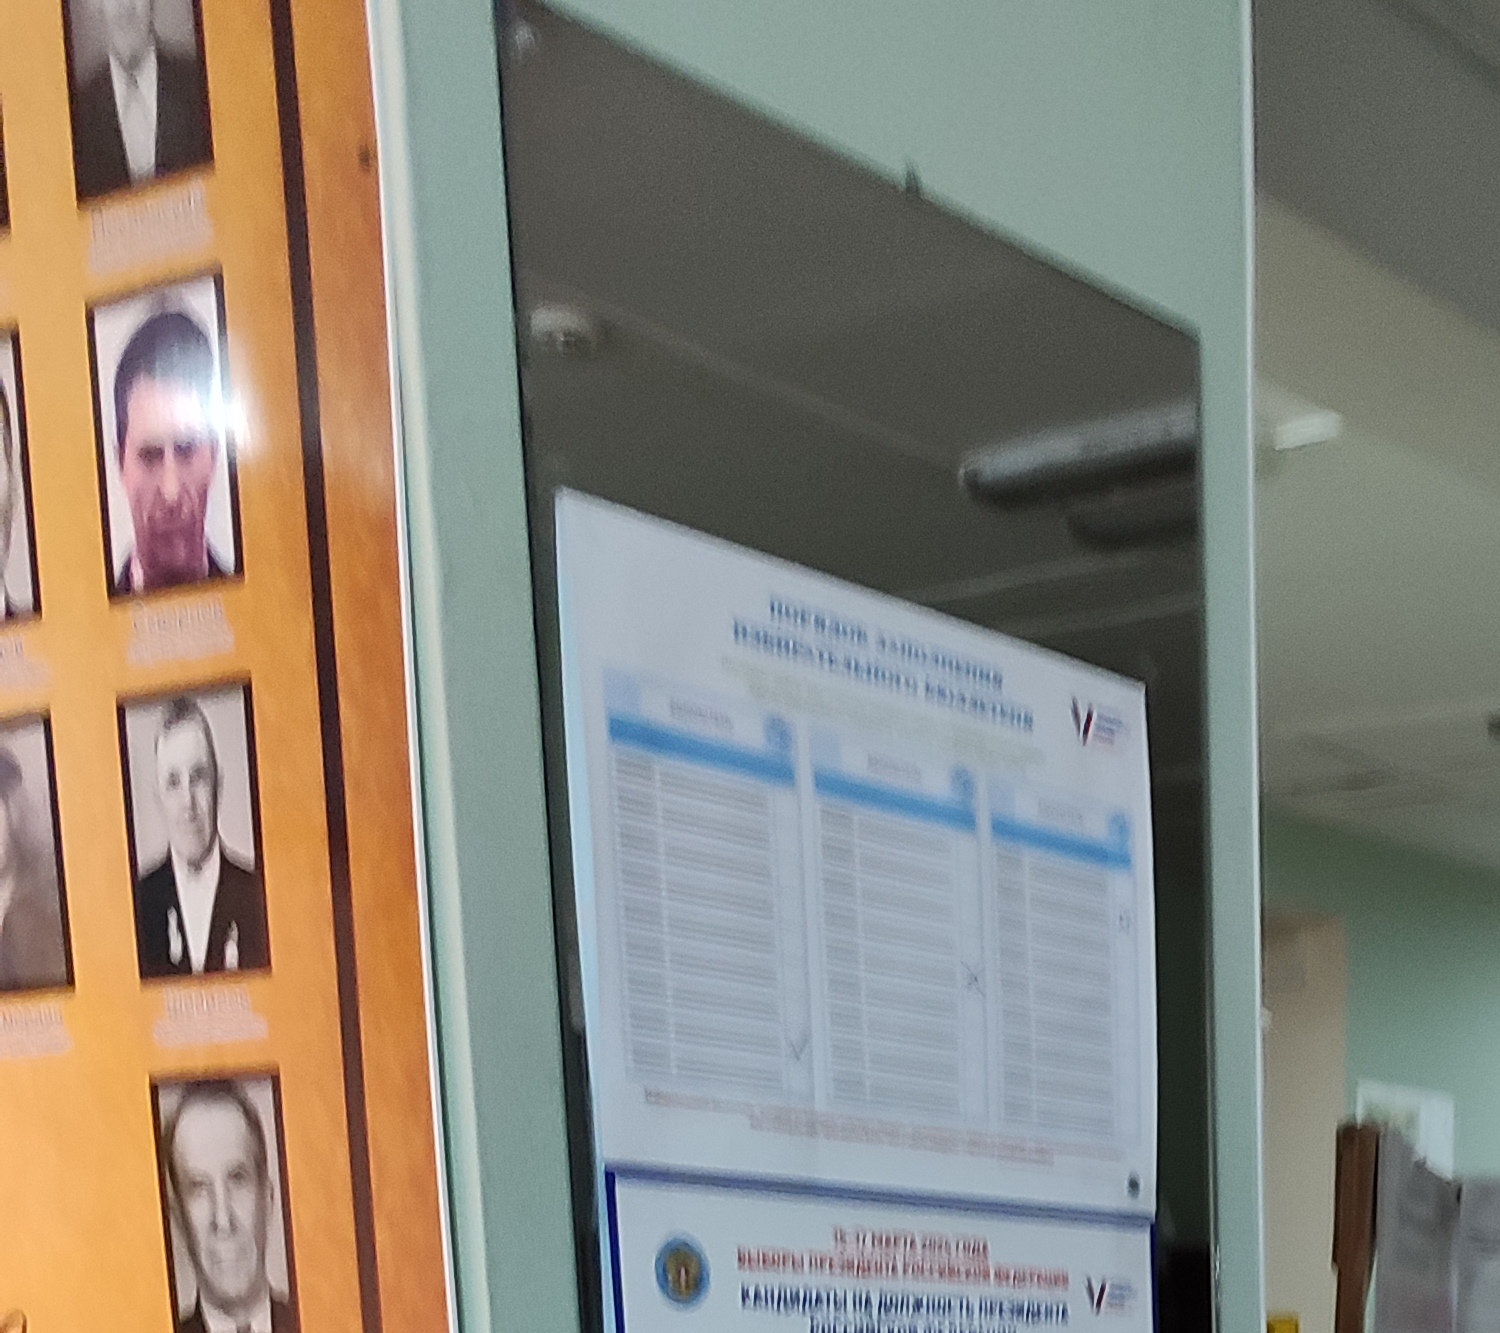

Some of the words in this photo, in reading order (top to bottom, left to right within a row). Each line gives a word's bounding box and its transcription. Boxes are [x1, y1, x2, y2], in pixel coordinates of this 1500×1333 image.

[871, 1230, 917, 1251] МАРТА
[737, 1248, 805, 1273] ВЫБОРЫ
[808, 1253, 900, 1279] ПРЕЗИДЕНТА
[902, 1259, 991, 1284] РОССИЙСКОЙ
[993, 1264, 1069, 1291] ФЕДЕРАЦИИ
[741, 1283, 848, 1316] КАНДИДАТЫ
[852, 1287, 874, 1317] НА
[876, 1289, 976, 1322] ДОЛЖНОСТЬ
[979, 1293, 1069, 1326] ПРЕЗИДЕНТА
